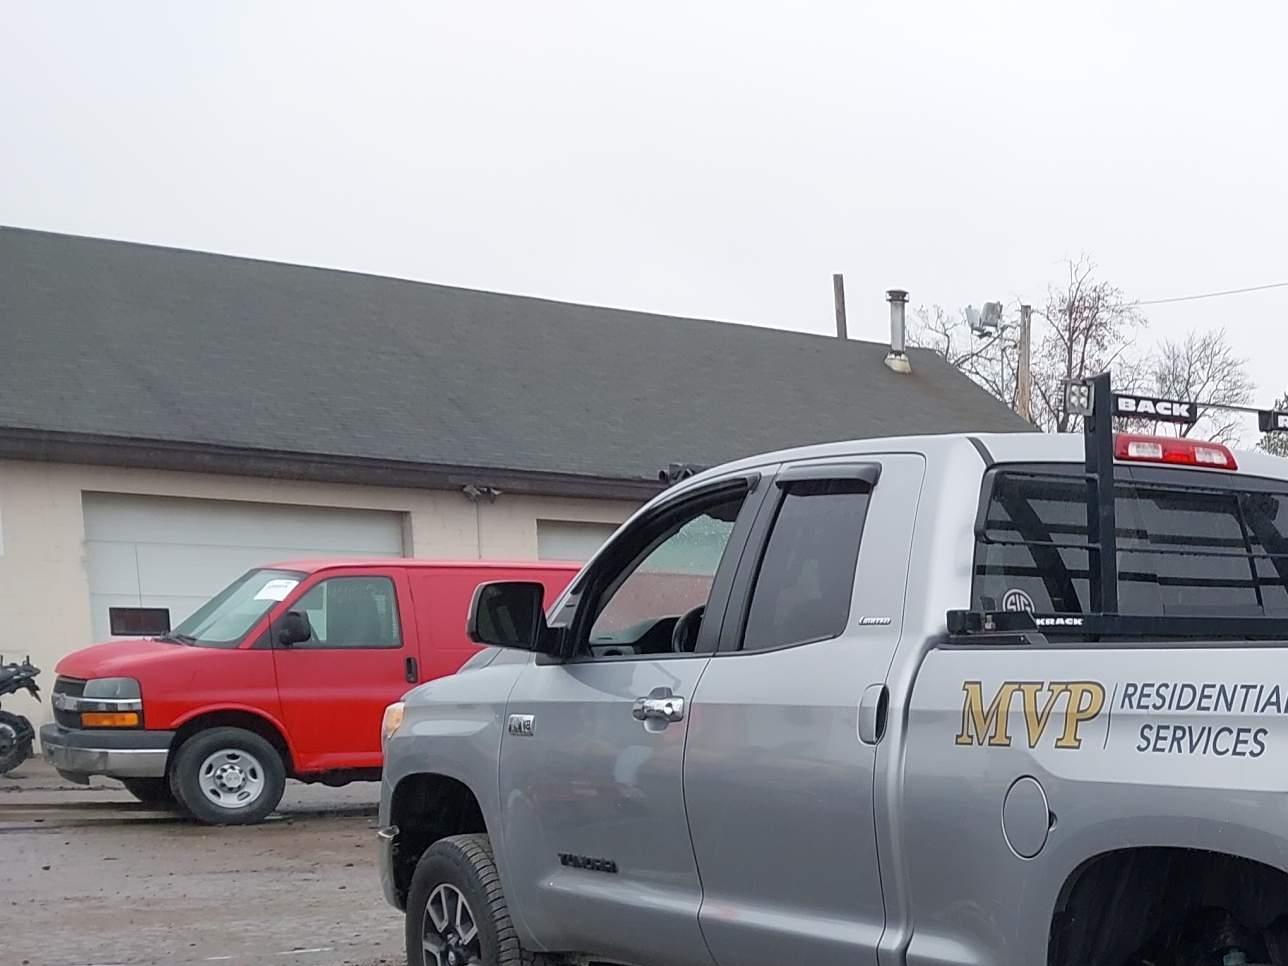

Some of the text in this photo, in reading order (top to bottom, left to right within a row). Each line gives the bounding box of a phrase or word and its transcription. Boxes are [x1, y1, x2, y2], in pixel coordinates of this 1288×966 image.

[1117, 398, 1190, 417] BACK
[955, 681, 1106, 750] MVP
[1136, 724, 1269, 758] SERVICES
